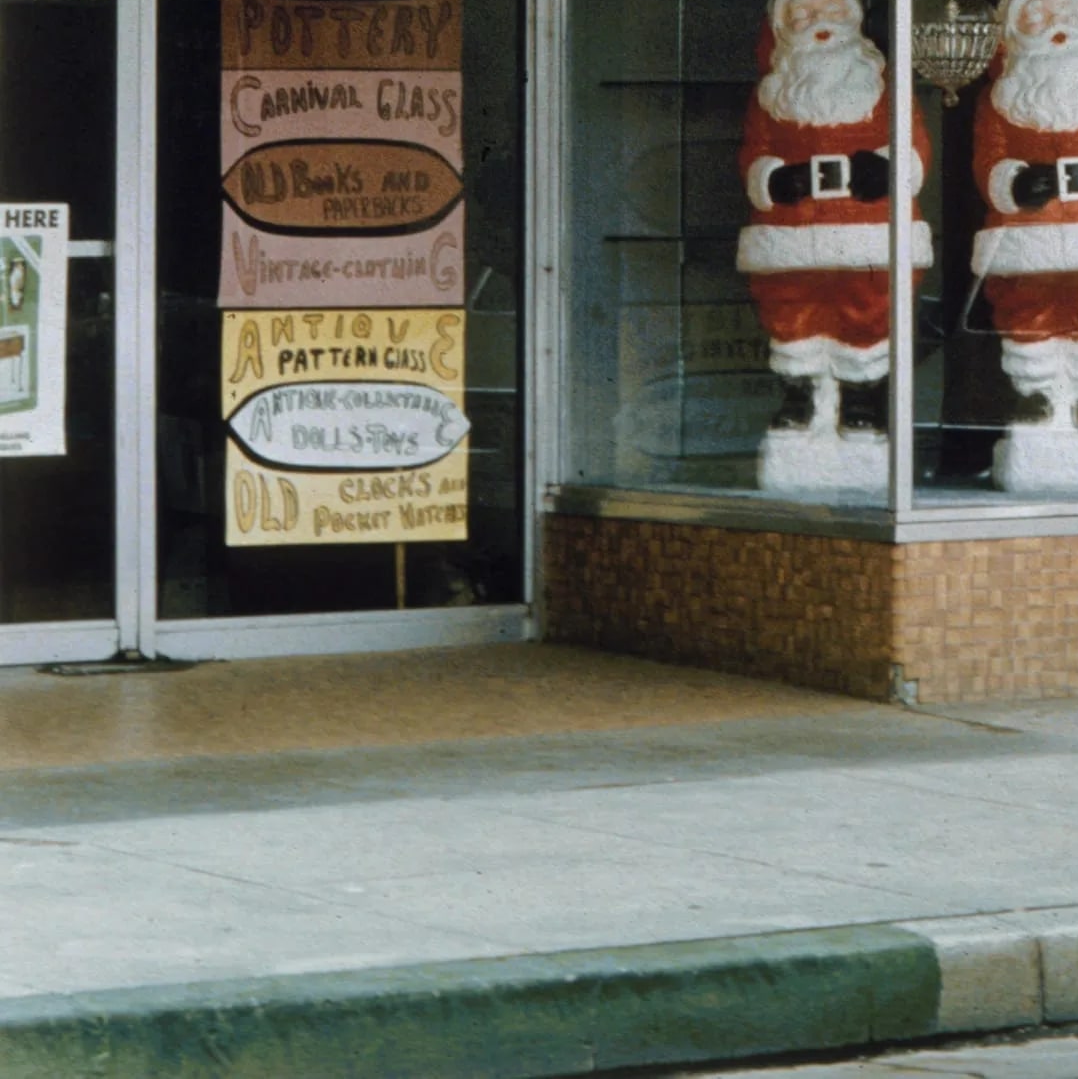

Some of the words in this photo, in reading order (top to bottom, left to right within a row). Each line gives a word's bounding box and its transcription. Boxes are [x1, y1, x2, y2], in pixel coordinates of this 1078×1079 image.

[376, 78, 458, 138] GLASS
[381, 170, 430, 194] AND
[5, 208, 59, 229] HERE
[322, 195, 426, 222] PAPERBACKS
[229, 312, 461, 383] ANTIQUE
[278, 344, 379, 376] PATTERN
[233, 470, 300, 535] OLD
[338, 472, 433, 505] CLOCKS
[313, 505, 392, 538] POCKET
